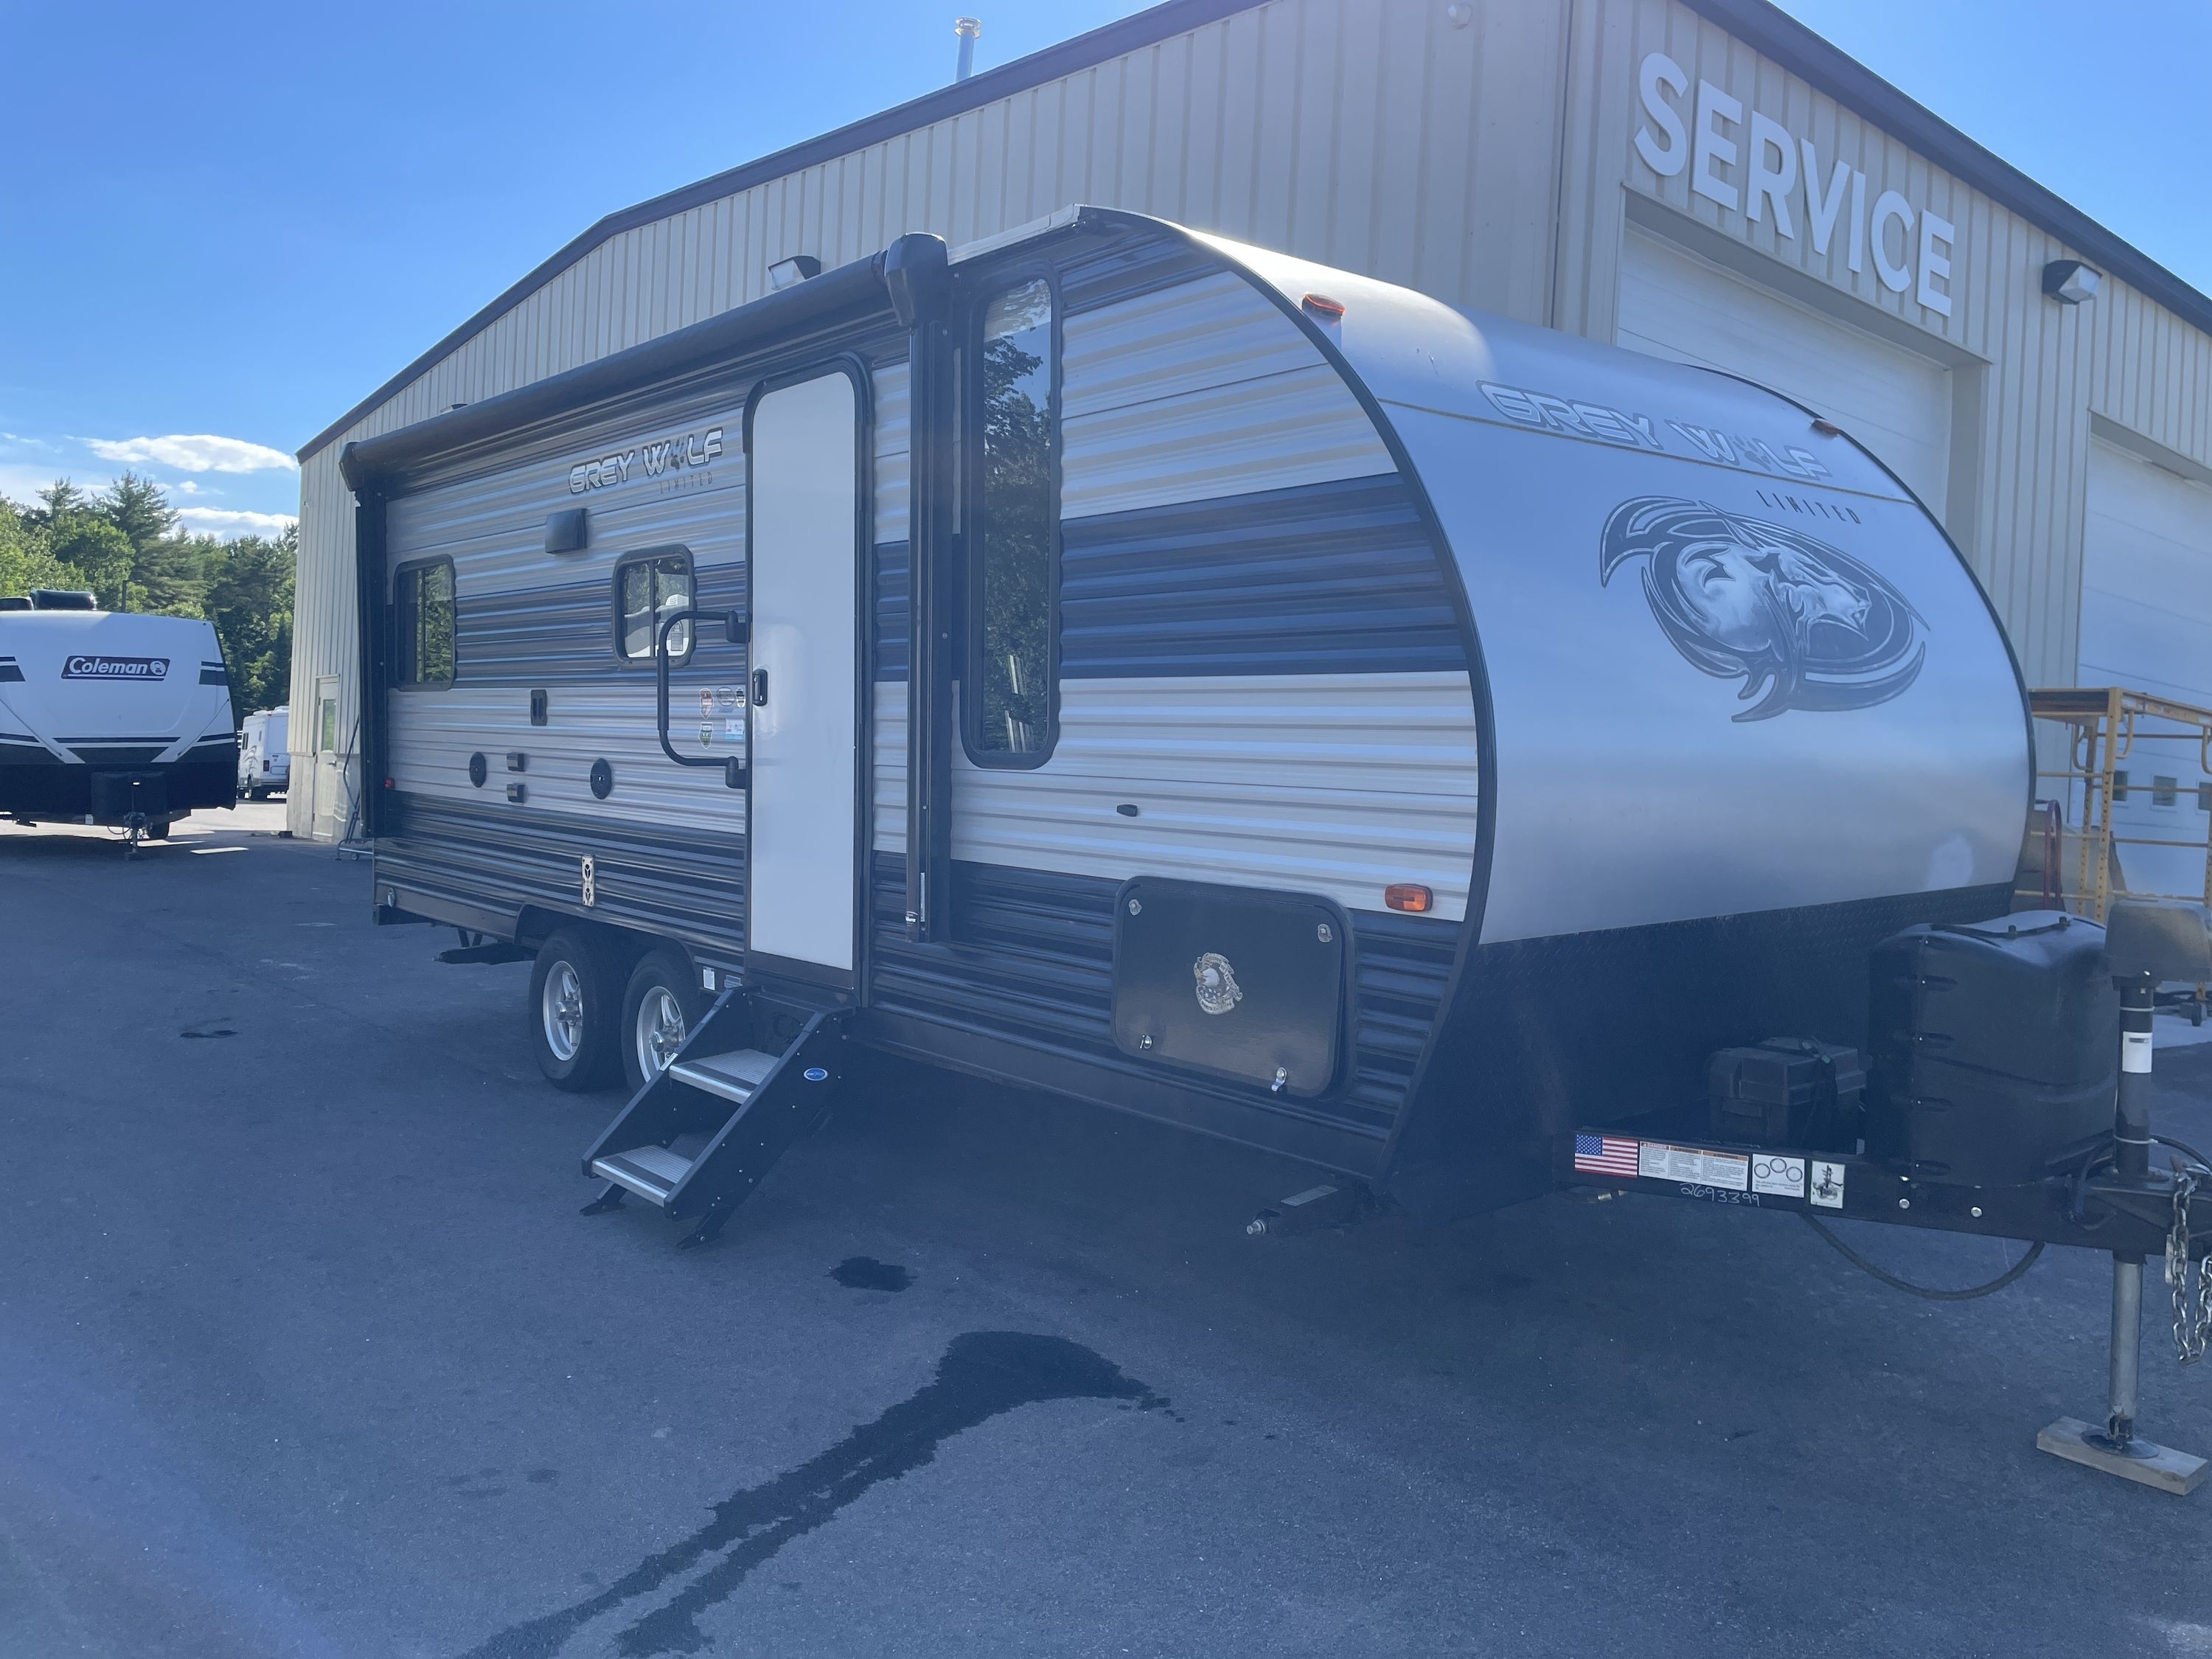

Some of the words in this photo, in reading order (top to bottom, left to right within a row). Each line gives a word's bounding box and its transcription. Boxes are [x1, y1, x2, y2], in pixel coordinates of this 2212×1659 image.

[1634, 52, 1955, 317] SERVICE
[1476, 381, 1663, 449] GREY
[569, 450, 635, 494] GREY
[660, 472, 713, 495] LIMITED
[1756, 490, 1861, 524] LIMITED
[69, 657, 148, 675] Coleman
[1679, 1183, 1761, 1207] 2693399
